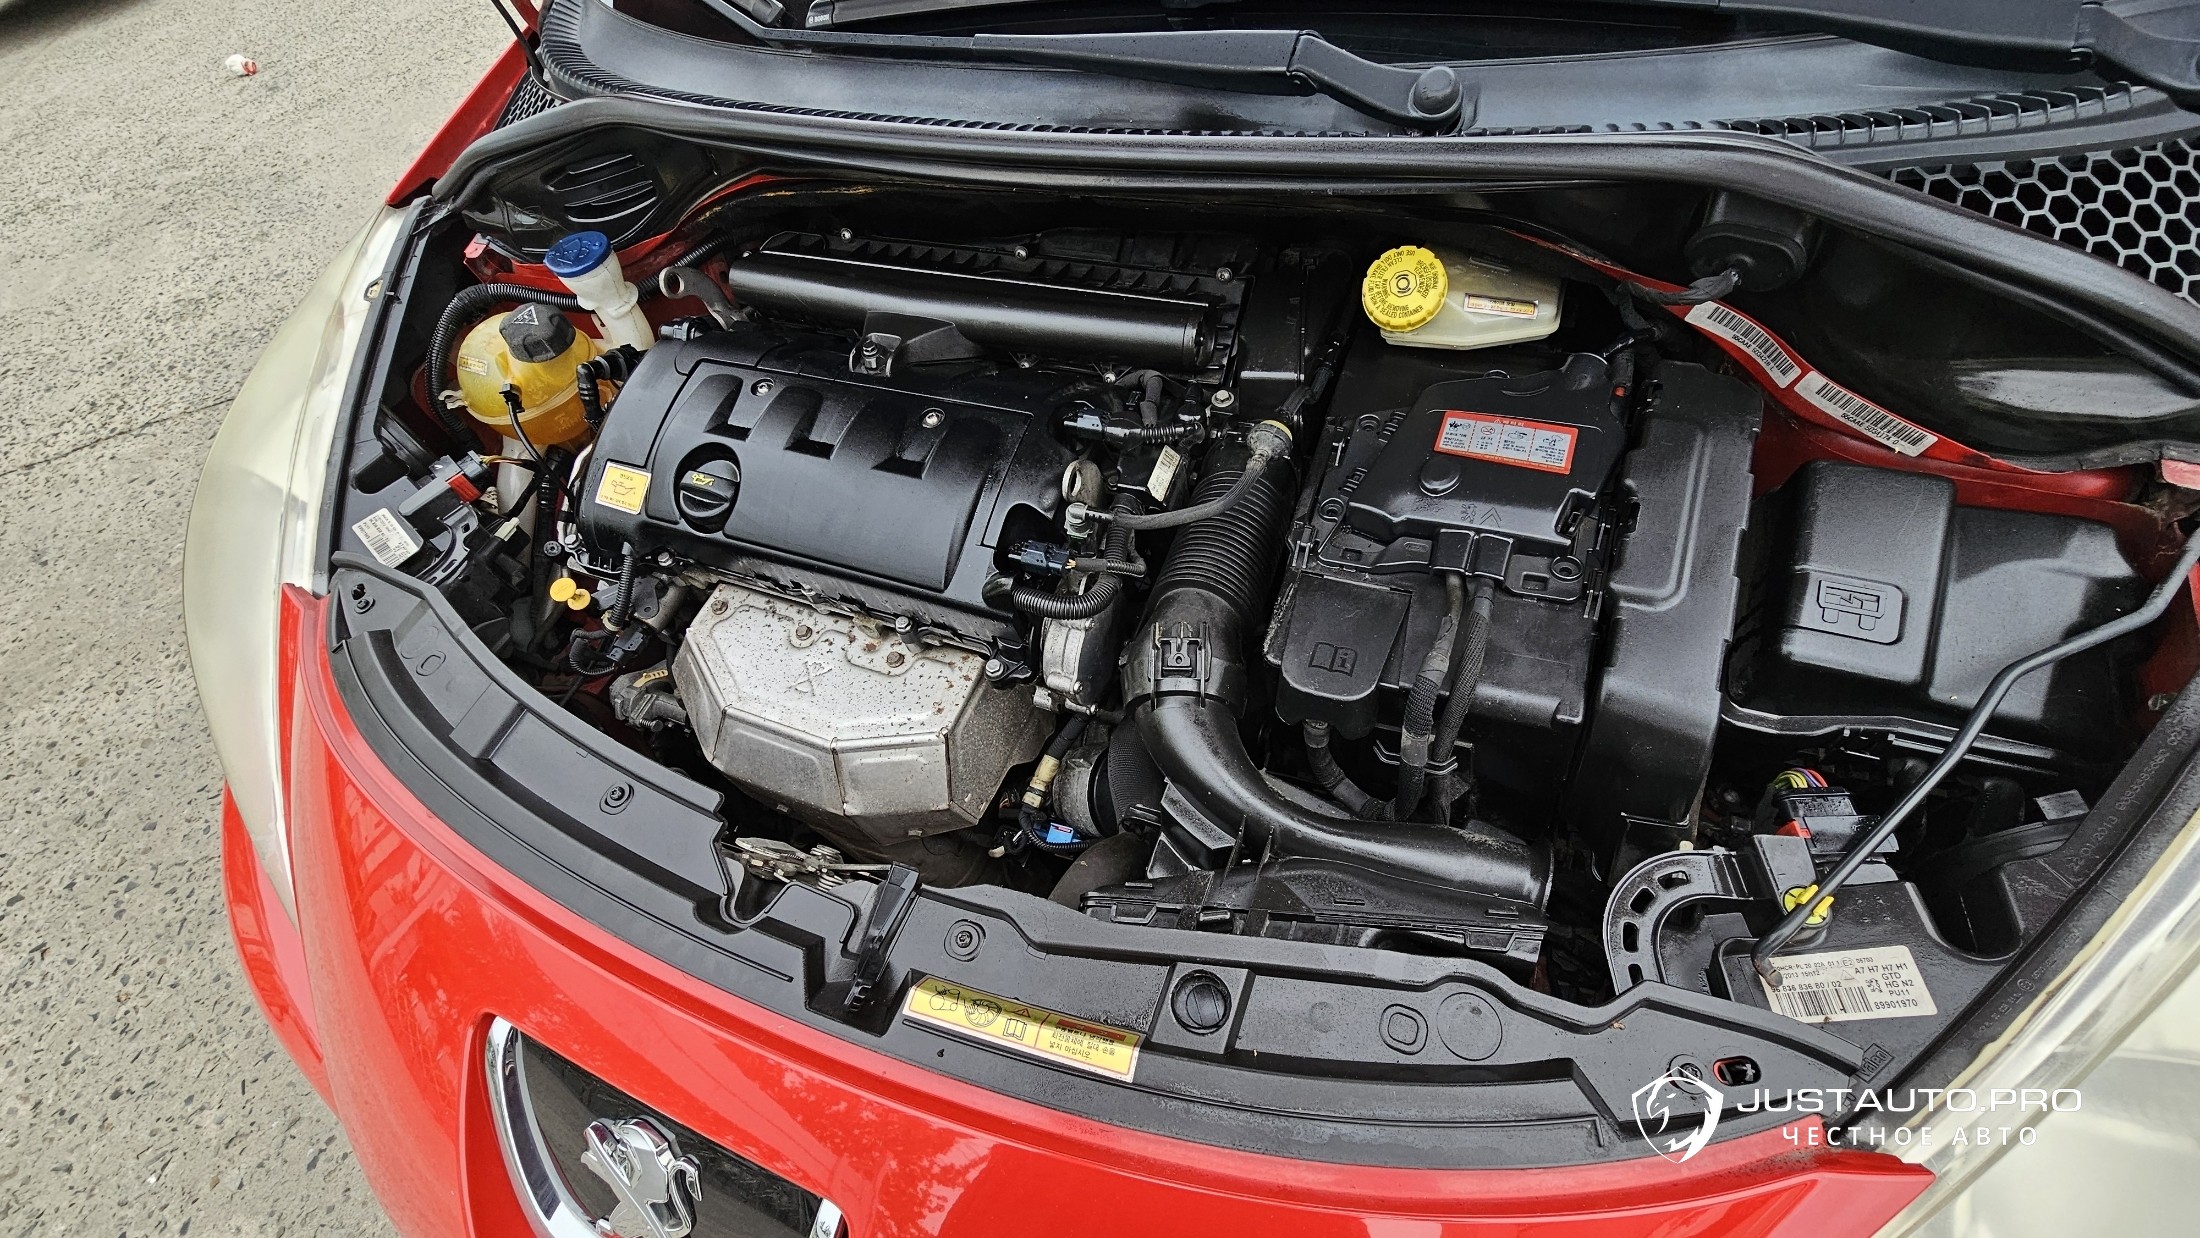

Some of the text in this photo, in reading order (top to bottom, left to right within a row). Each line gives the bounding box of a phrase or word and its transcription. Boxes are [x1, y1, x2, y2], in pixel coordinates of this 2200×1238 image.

[1867, 965, 1879, 973] H7
[1901, 979, 1915, 987] N2
[1874, 998, 1918, 1010] 89901970
